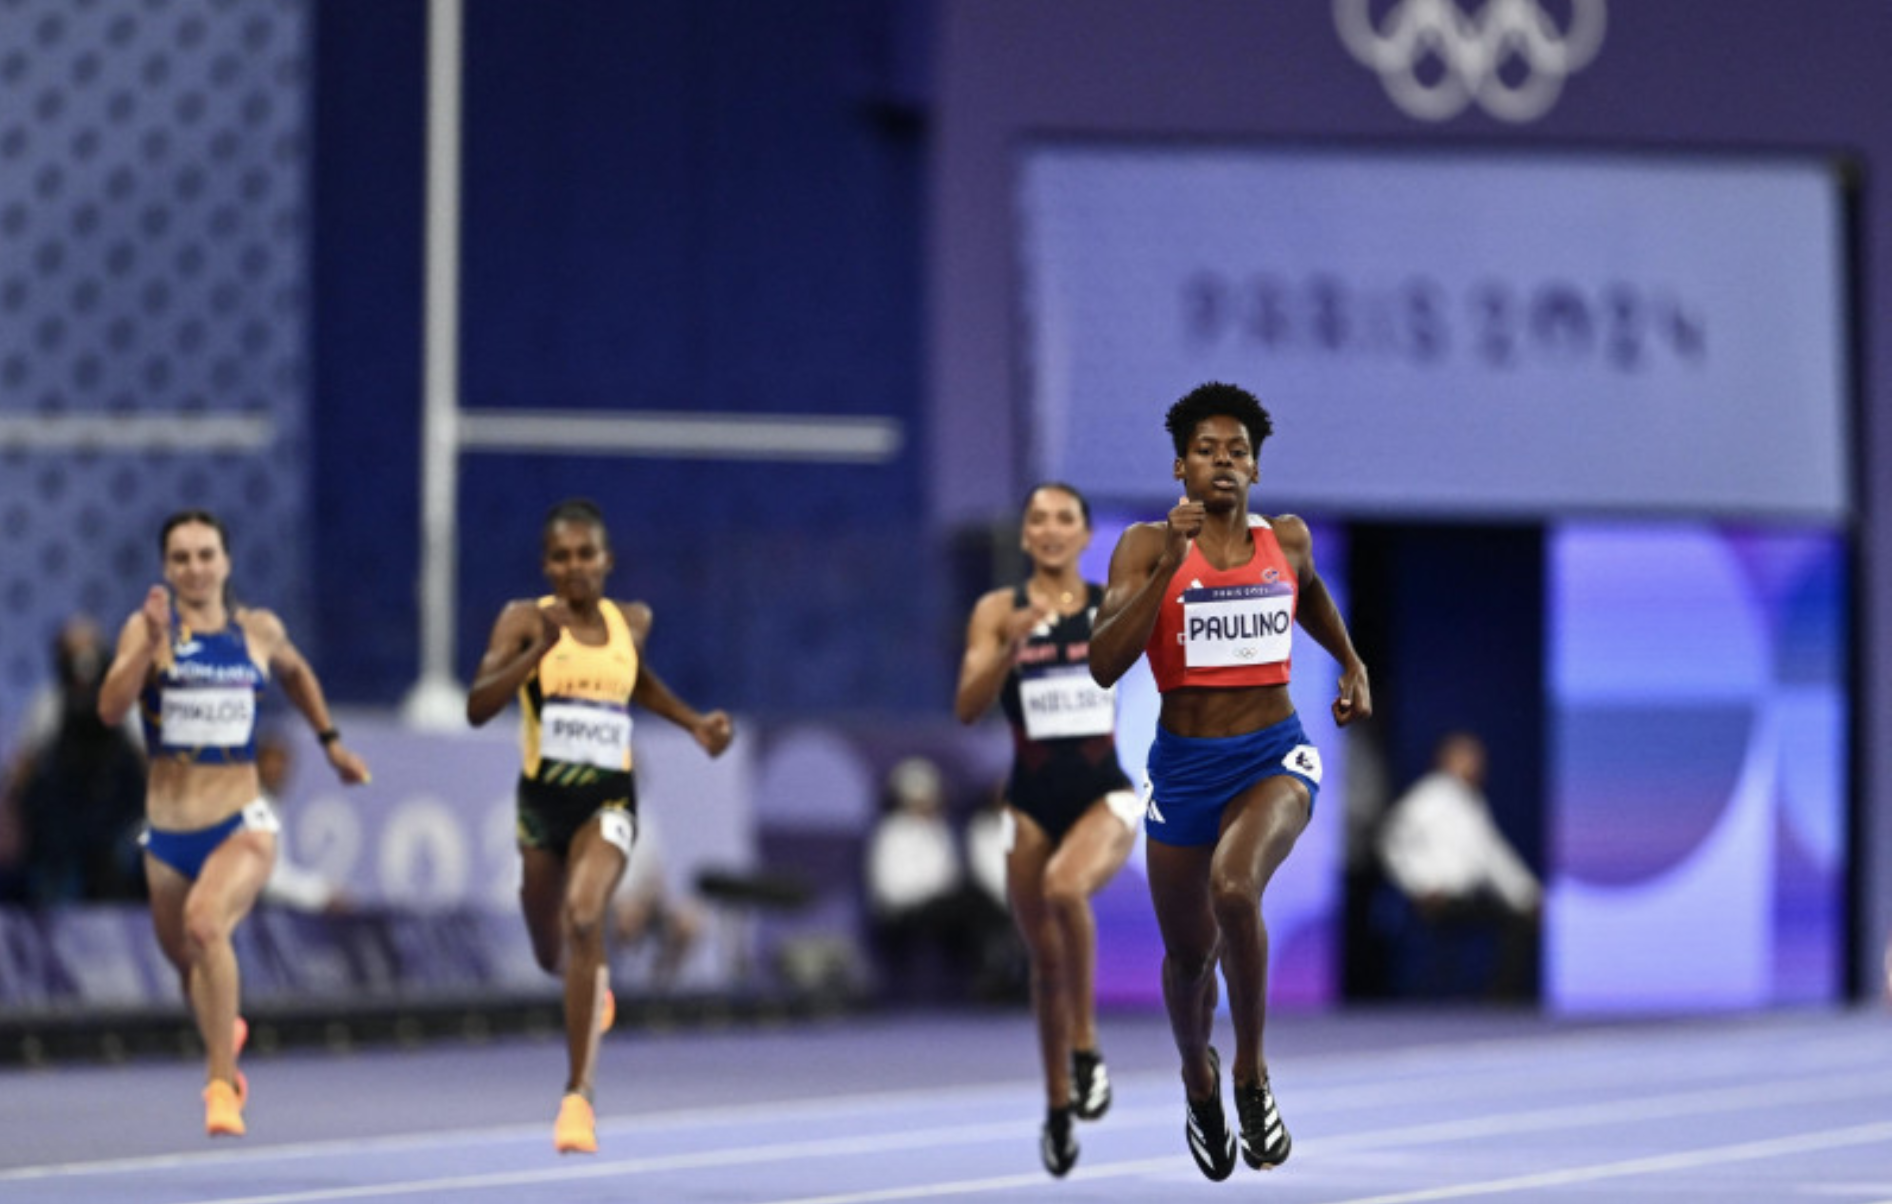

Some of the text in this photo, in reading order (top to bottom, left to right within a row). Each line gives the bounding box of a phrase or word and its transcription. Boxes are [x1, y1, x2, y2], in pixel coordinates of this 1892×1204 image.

[1181, 270, 1706, 371] PARIS 2024
[1189, 609, 1290, 641] PAULINO
